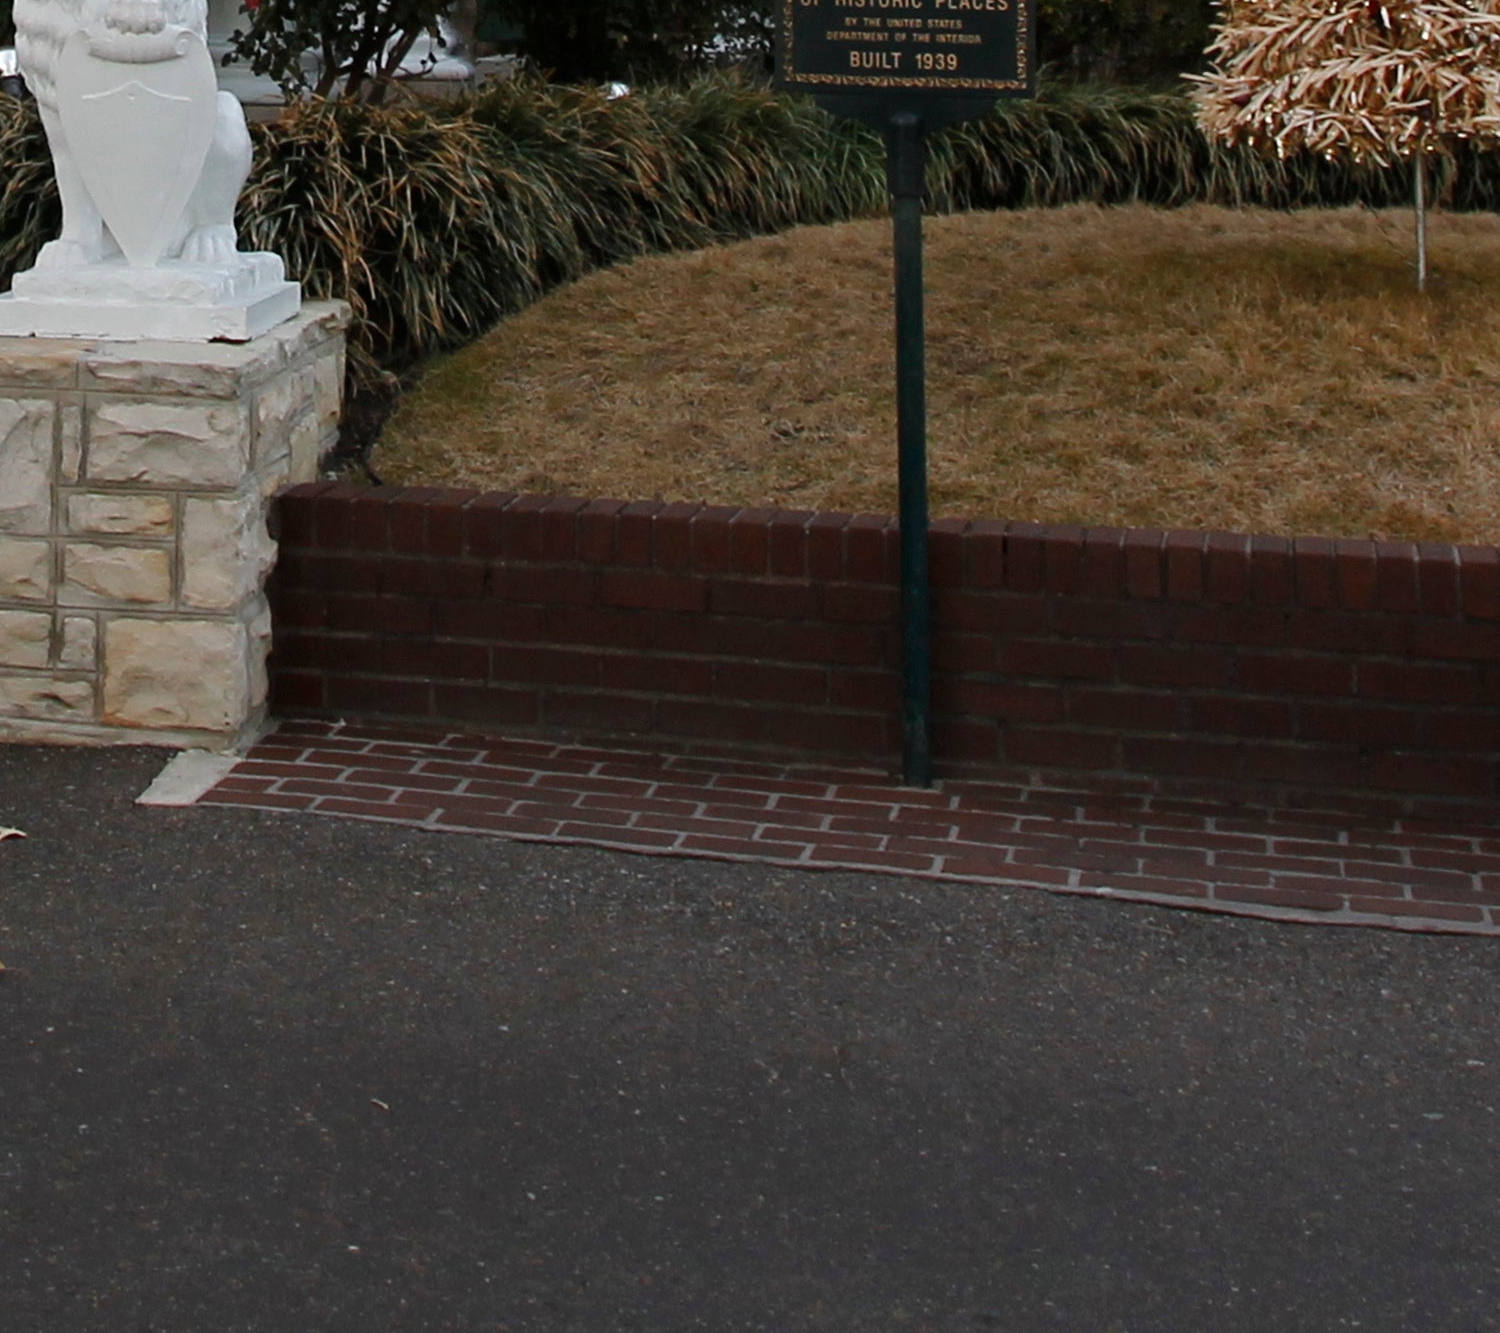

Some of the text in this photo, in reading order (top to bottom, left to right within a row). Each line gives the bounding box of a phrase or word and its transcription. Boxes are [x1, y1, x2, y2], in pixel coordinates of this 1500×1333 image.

[845, 17, 962, 29] BY THE UNITED STATES
[826, 31, 982, 44] DEPARTMENT OF THE INTERIOR
[850, 51, 958, 70] BUILT 1939
